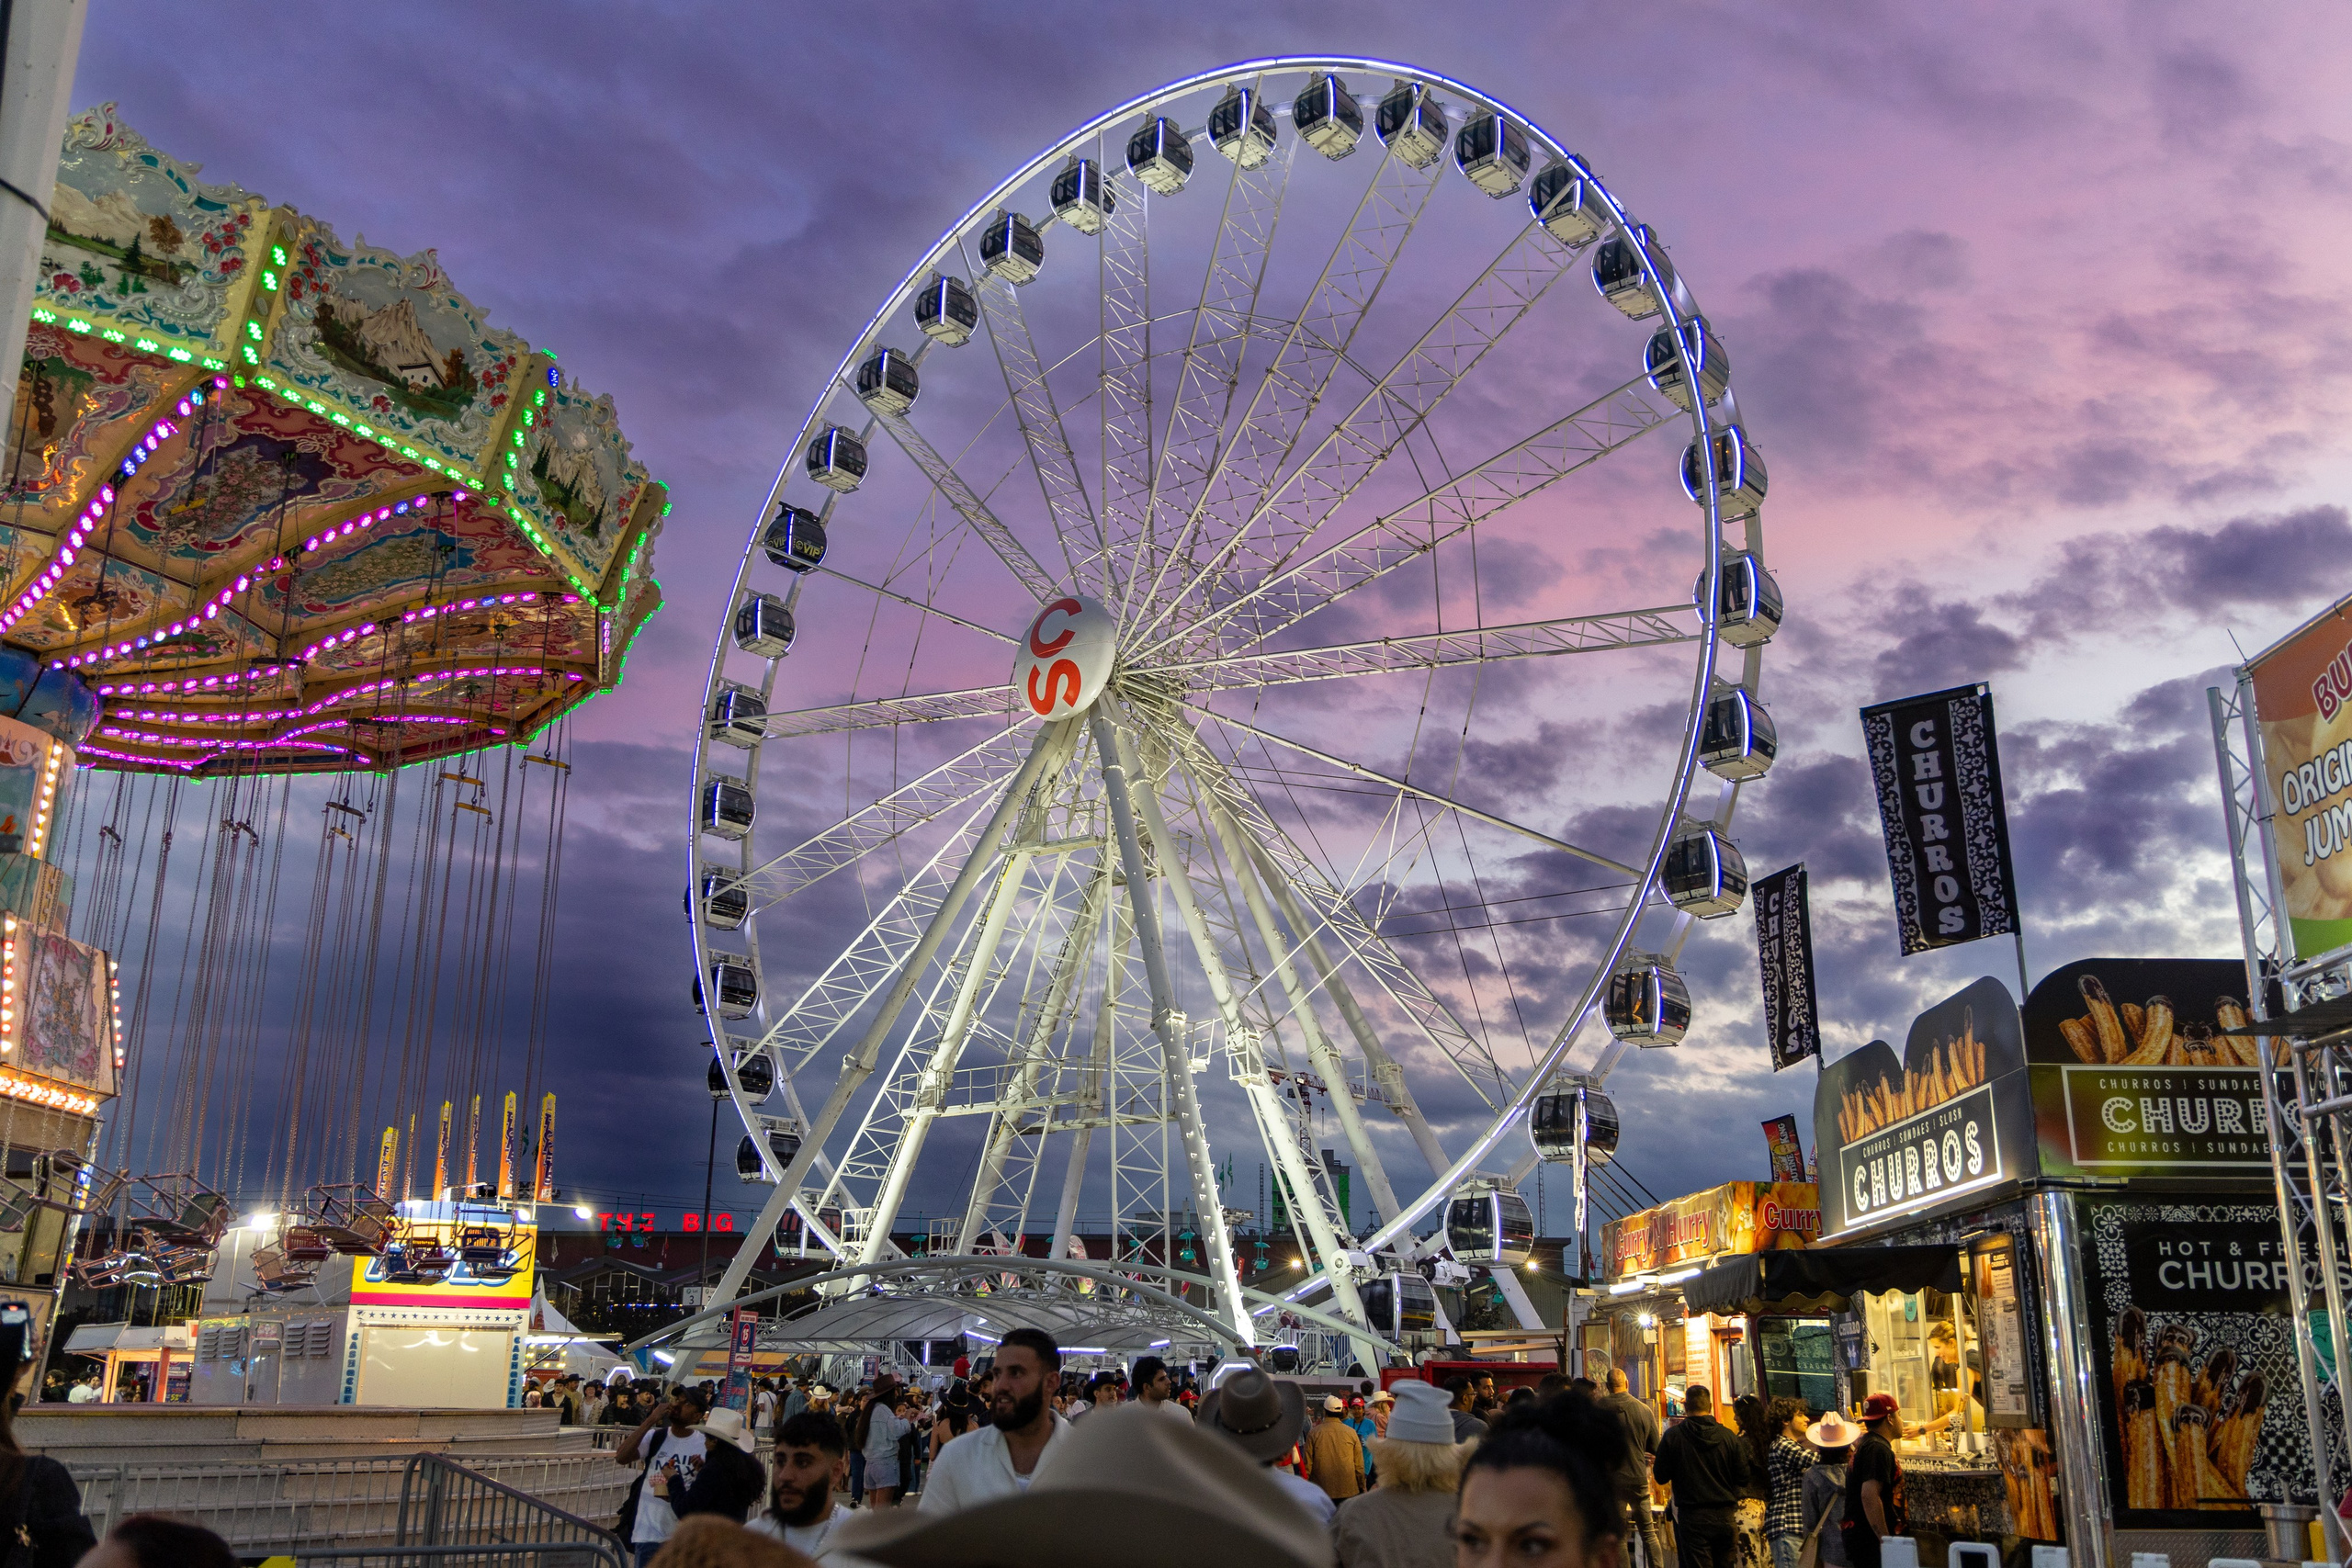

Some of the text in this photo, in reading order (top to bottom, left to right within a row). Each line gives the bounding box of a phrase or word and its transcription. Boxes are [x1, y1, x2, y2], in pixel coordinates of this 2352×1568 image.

[802, 542, 820, 558] VIP
[1910, 719, 1965, 934] CHURROS
[2099, 1078, 2172, 1090] CHURROS
[2199, 1079, 2260, 1090] SUNDAE
[1862, 1137, 1891, 1158] CHURROS
[1899, 1121, 1929, 1144] SUNDAES
[1939, 1106, 1962, 1127] SLUSH
[2108, 1141, 2180, 1153] CHURROS
[2208, 1143, 2271, 1154] SUNDAE
[1853, 1120, 1983, 1213] CHURROS
[597, 1213, 733, 1232] THE BIG
[1614, 1208, 1713, 1262] Curry N Hurry
[2159, 1242, 2211, 1256] HOT
[2229, 1242, 2242, 1256] &
[689, 1295, 695, 1304] 3
